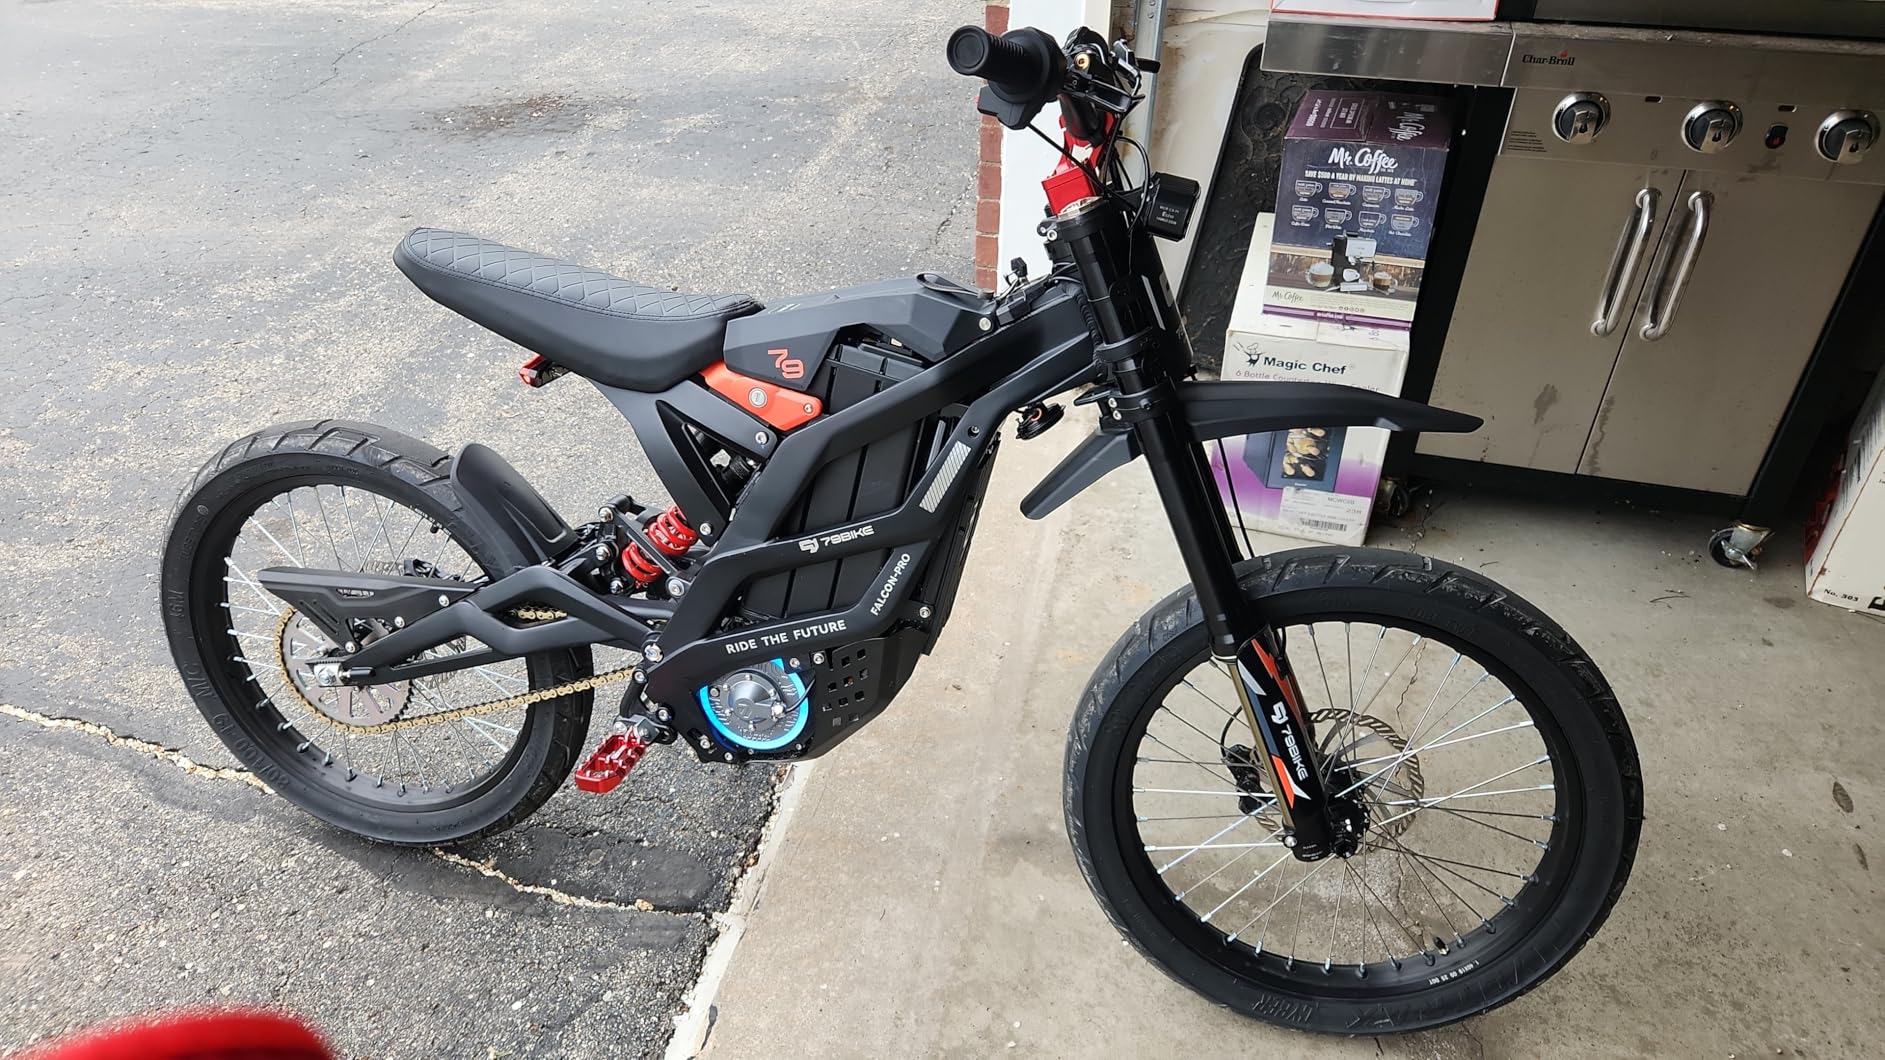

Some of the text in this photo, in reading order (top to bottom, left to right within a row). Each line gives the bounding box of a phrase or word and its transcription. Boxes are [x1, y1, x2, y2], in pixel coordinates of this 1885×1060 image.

[1522, 54, 1576, 66] Char-Broil
[1328, 148, 1399, 174] Mr. Coffee
[1336, 173, 1349, 181] YEAR
[1284, 291, 1305, 304] Coffee
[768, 348, 804, 379] 79
[1263, 356, 1347, 375] Magic Chef
[1235, 369, 1242, 377] 6
[1244, 370, 1270, 380] Bottle
[820, 525, 875, 547] 79BIKE
[870, 553, 911, 616] FALCON-PRO
[1823, 588, 1839, 598] No.
[725, 619, 847, 654] RIDE THE FUTURE
[1281, 724, 1309, 781] 79BIKE
